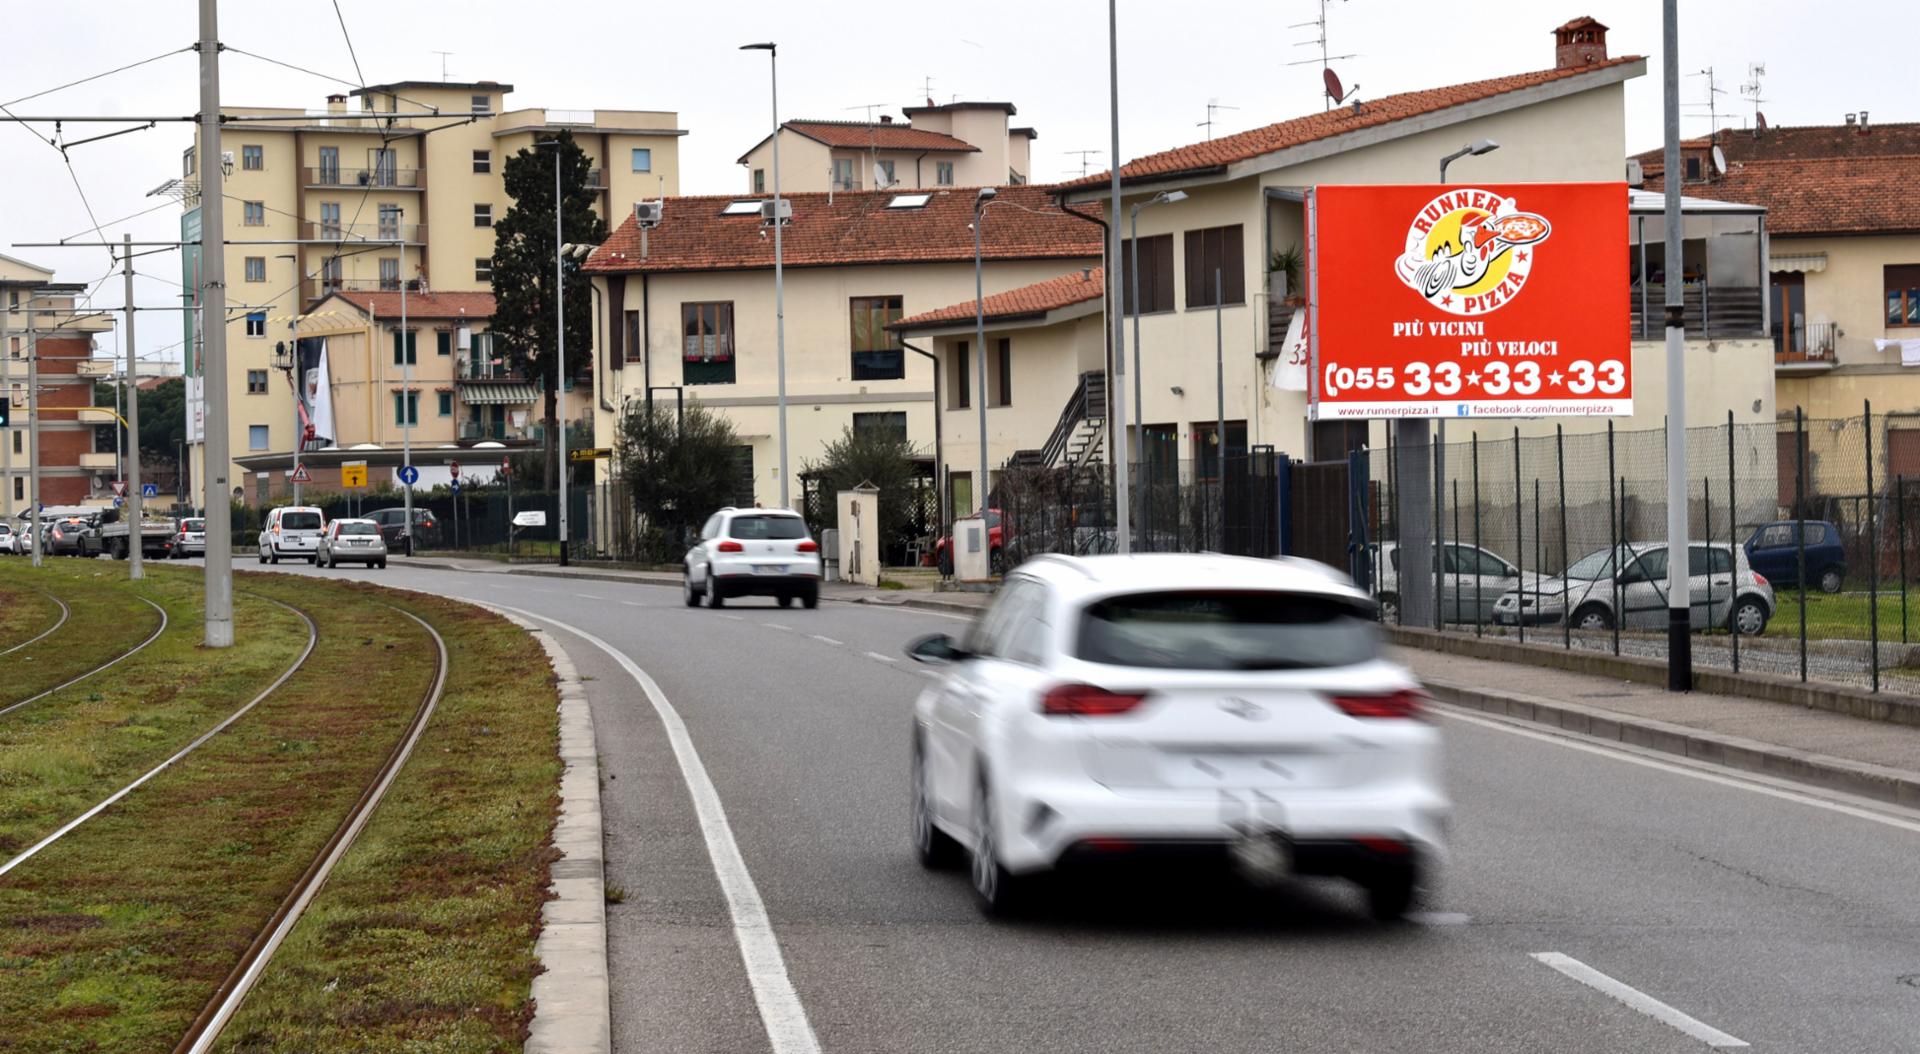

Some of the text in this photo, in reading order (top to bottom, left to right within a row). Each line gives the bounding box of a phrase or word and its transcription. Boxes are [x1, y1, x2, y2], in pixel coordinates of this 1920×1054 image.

[1414, 191, 1501, 234] RUNNER
[1464, 271, 1525, 313] PIZZA
[1393, 318, 1485, 337] PIÙ VICINI
[1461, 338, 1558, 356] PIÙ VELOCI
[1335, 367, 1396, 390] 055
[1338, 405, 1440, 417] www.runnerpizza.it
[1473, 403, 1614, 416] facebook.com/runnerpizza
